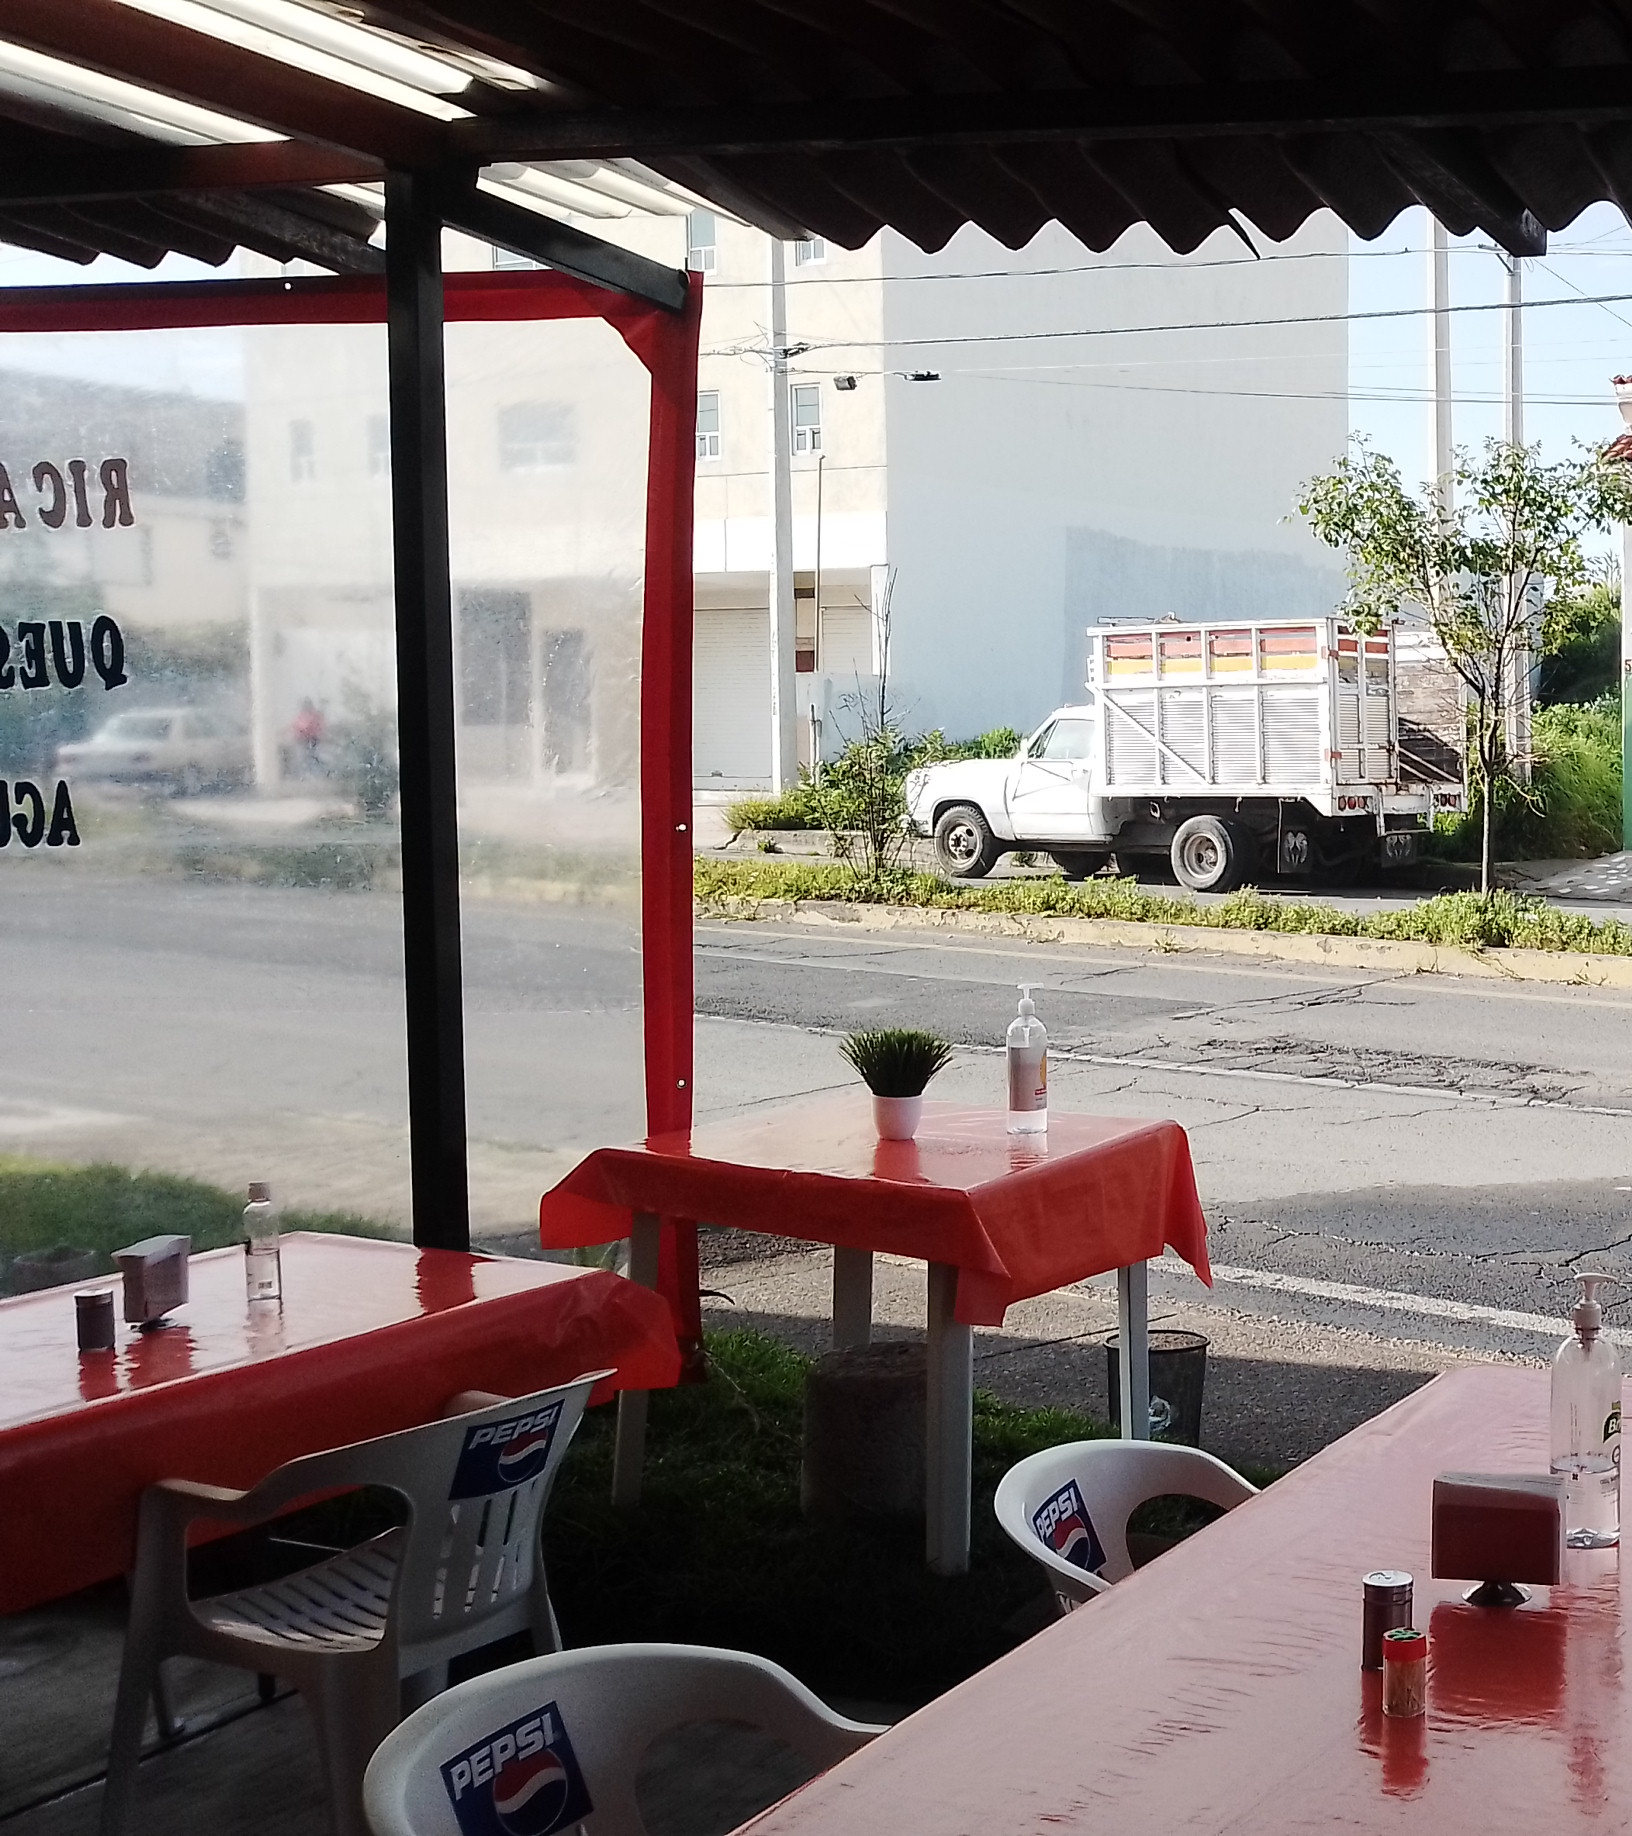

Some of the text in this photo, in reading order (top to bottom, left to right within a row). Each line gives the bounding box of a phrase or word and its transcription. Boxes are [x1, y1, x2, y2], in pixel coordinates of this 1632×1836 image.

[468, 1405, 560, 1450] PEPSI
[1036, 1487, 1079, 1544] PEPSI
[450, 1711, 555, 1801] PEPSI
